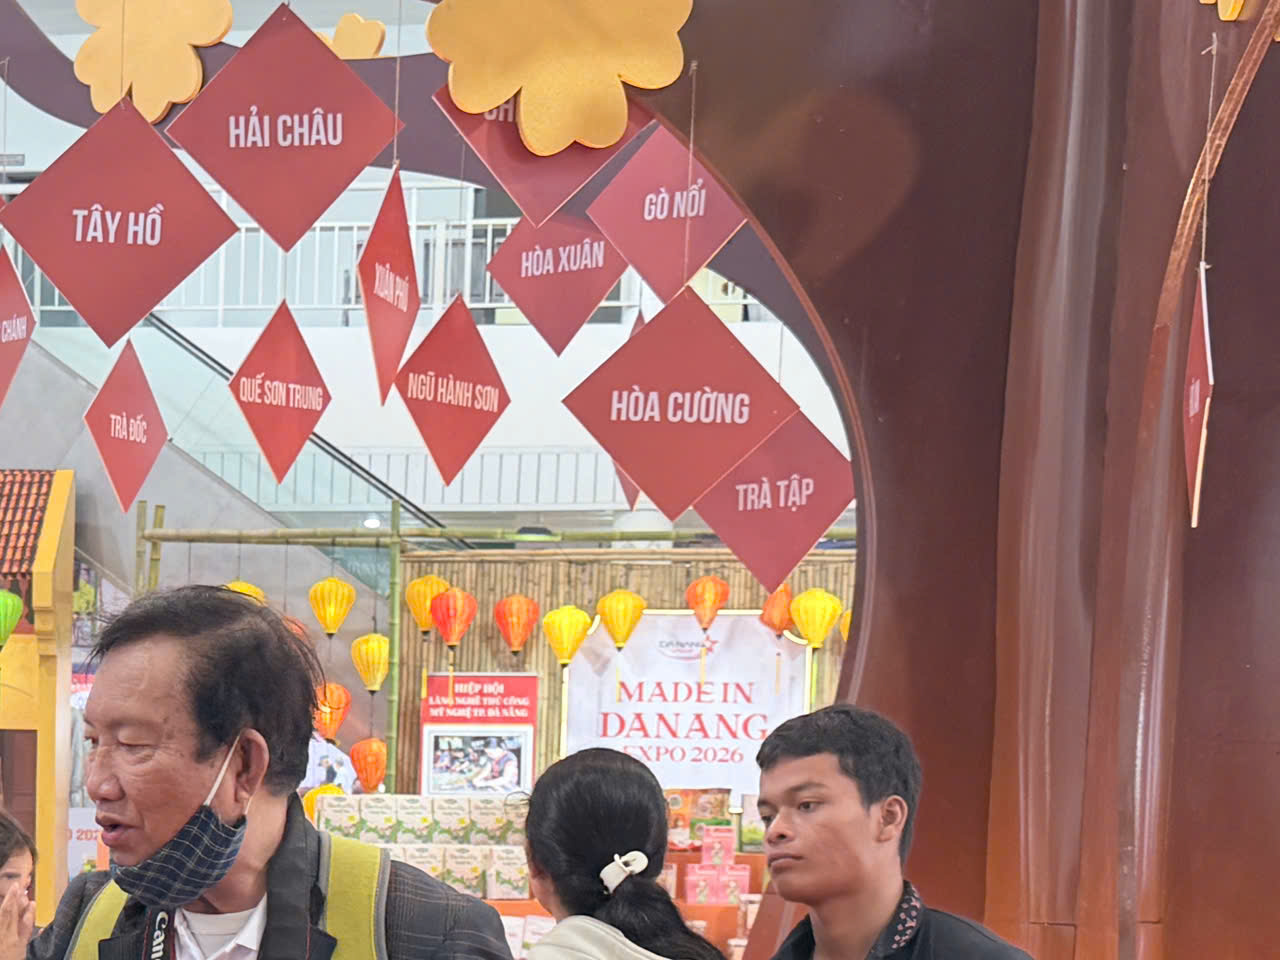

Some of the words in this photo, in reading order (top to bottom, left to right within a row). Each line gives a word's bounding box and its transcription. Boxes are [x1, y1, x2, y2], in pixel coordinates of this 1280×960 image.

[228, 105, 270, 148] HẢI
[277, 107, 343, 147] CHÂU
[643, 187, 670, 221] GÒ
[672, 178, 706, 219] NỔI
[72, 203, 121, 243] TÂY
[126, 203, 164, 246] HỒ
[521, 245, 555, 278] HÒA
[558, 238, 605, 273] XUÂN
[240, 372, 264, 403] QUẾ
[264, 382, 286, 407] SƠN
[288, 384, 323, 411] TRUNG
[408, 371, 435, 400] NGŨ
[438, 373, 473, 407] HÀNH
[475, 384, 499, 412] SƠN
[610, 385, 661, 422] HÒA
[667, 386, 750, 424] CƯỜNG
[110, 412, 127, 440] TRÀ
[129, 414, 147, 444] ĐỐC
[736, 477, 772, 511] TRÀ
[776, 474, 814, 512] TẬP
[617, 681, 714, 704] MADE
[722, 682, 755, 704] IN
[600, 712, 768, 741] DANANG
[691, 747, 744, 763] 2026
